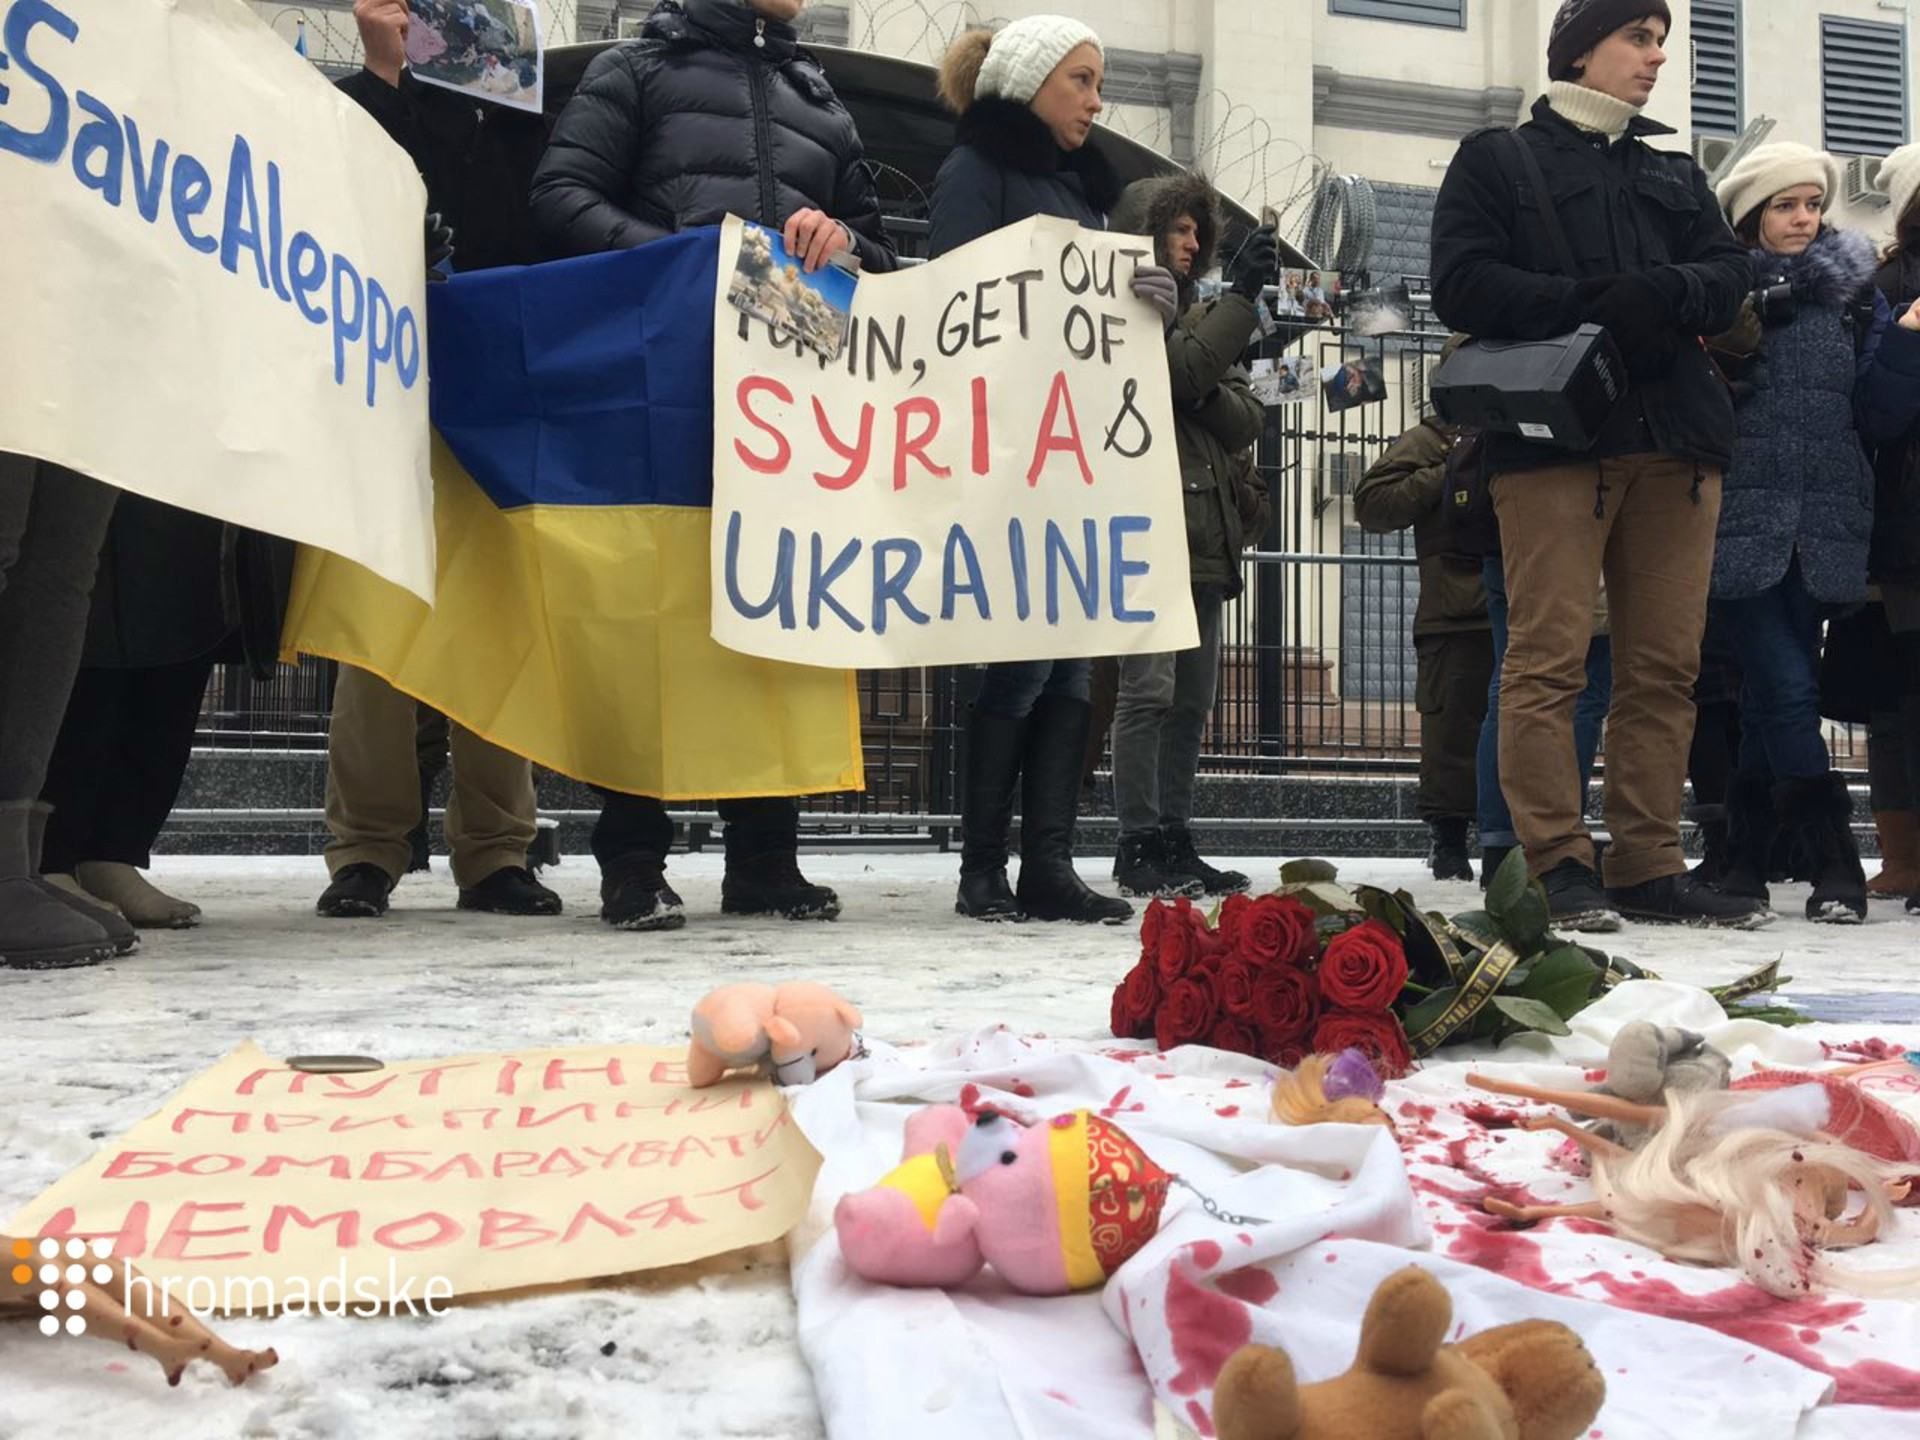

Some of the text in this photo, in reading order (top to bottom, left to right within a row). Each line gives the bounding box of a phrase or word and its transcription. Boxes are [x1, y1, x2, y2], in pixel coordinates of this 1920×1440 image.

[0, 0, 419, 407] SaveAleppo
[937, 270, 1043, 357] GET
[1060, 241, 1151, 298] OUT
[1064, 304, 1127, 364] OF
[734, 370, 1153, 491] SYRIA &
[724, 510, 1156, 635] UKRAINE
[101, 1110, 790, 1182] БОМБАРДУВАТИ
[171, 1086, 753, 1134] ПРИПИНИ
[37, 1164, 781, 1261] НЕМОВЛЯТ
